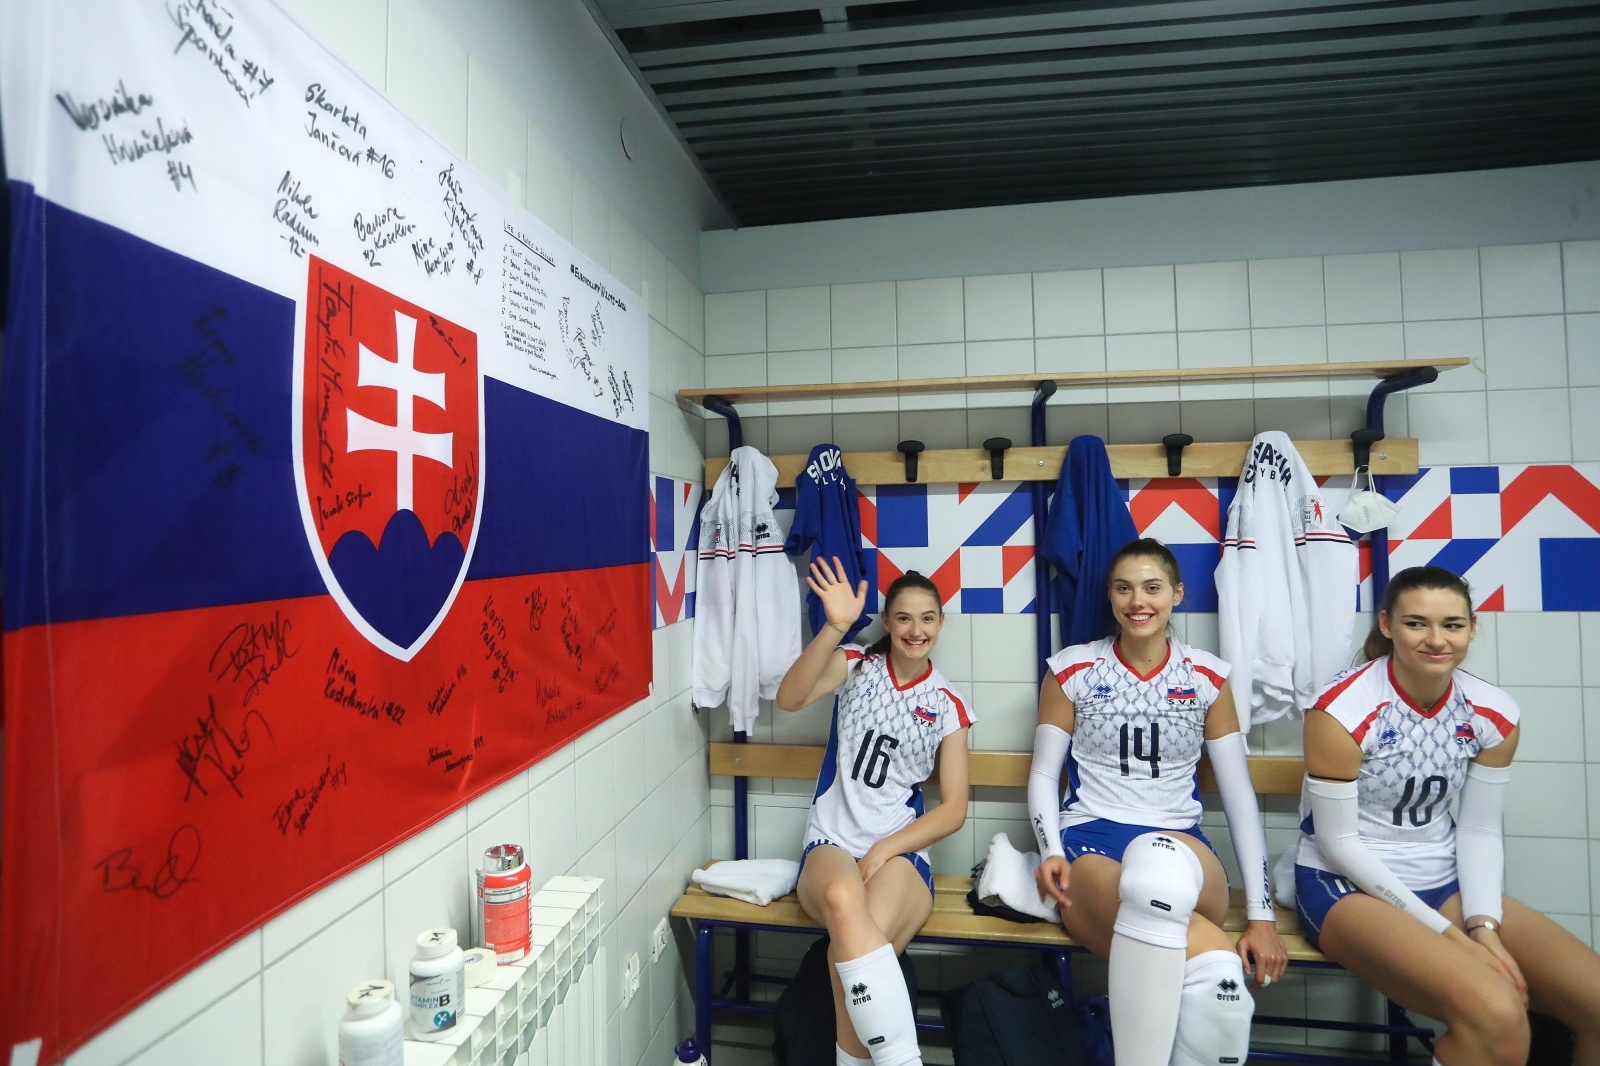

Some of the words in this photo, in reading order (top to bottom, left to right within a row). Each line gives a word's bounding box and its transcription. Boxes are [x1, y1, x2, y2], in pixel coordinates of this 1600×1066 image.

[366, 145, 396, 180] #16
[362, 249, 382, 267] #2
[913, 714, 934, 728] SVK
[851, 729, 899, 789] 16
[1119, 722, 1161, 778] 14
[1393, 775, 1449, 828] 10
[1152, 842, 1176, 851] errea
[1384, 889, 1407, 910] errea
[439, 994, 451, 1007] B
[852, 994, 872, 1006] errea
[1217, 993, 1240, 1001] errea
